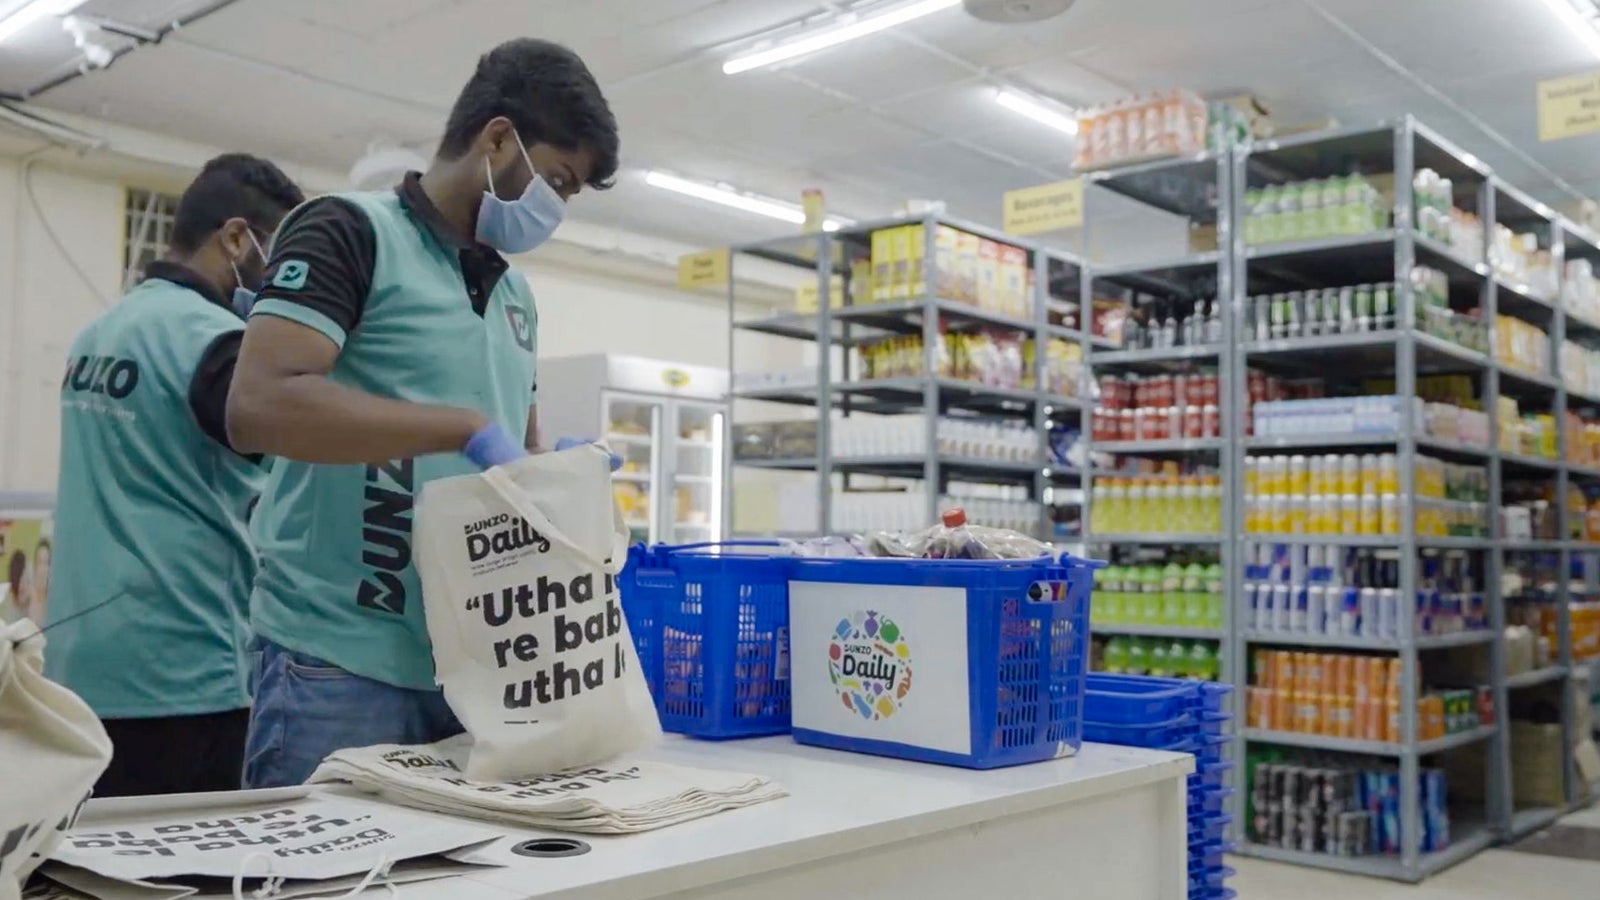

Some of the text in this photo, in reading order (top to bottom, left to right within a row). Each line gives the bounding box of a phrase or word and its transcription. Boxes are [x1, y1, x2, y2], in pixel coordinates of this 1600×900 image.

[357, 459, 413, 615] DUNZ
[464, 513, 509, 535] DUNZO
[466, 516, 550, 562] Daily
[494, 600, 621, 668] re bab
[844, 643, 872, 655] DUNZO
[503, 658, 604, 709] utha
[842, 654, 896, 690] Daily
[153, 808, 298, 834] utha
[273, 828, 389, 857] Daily
